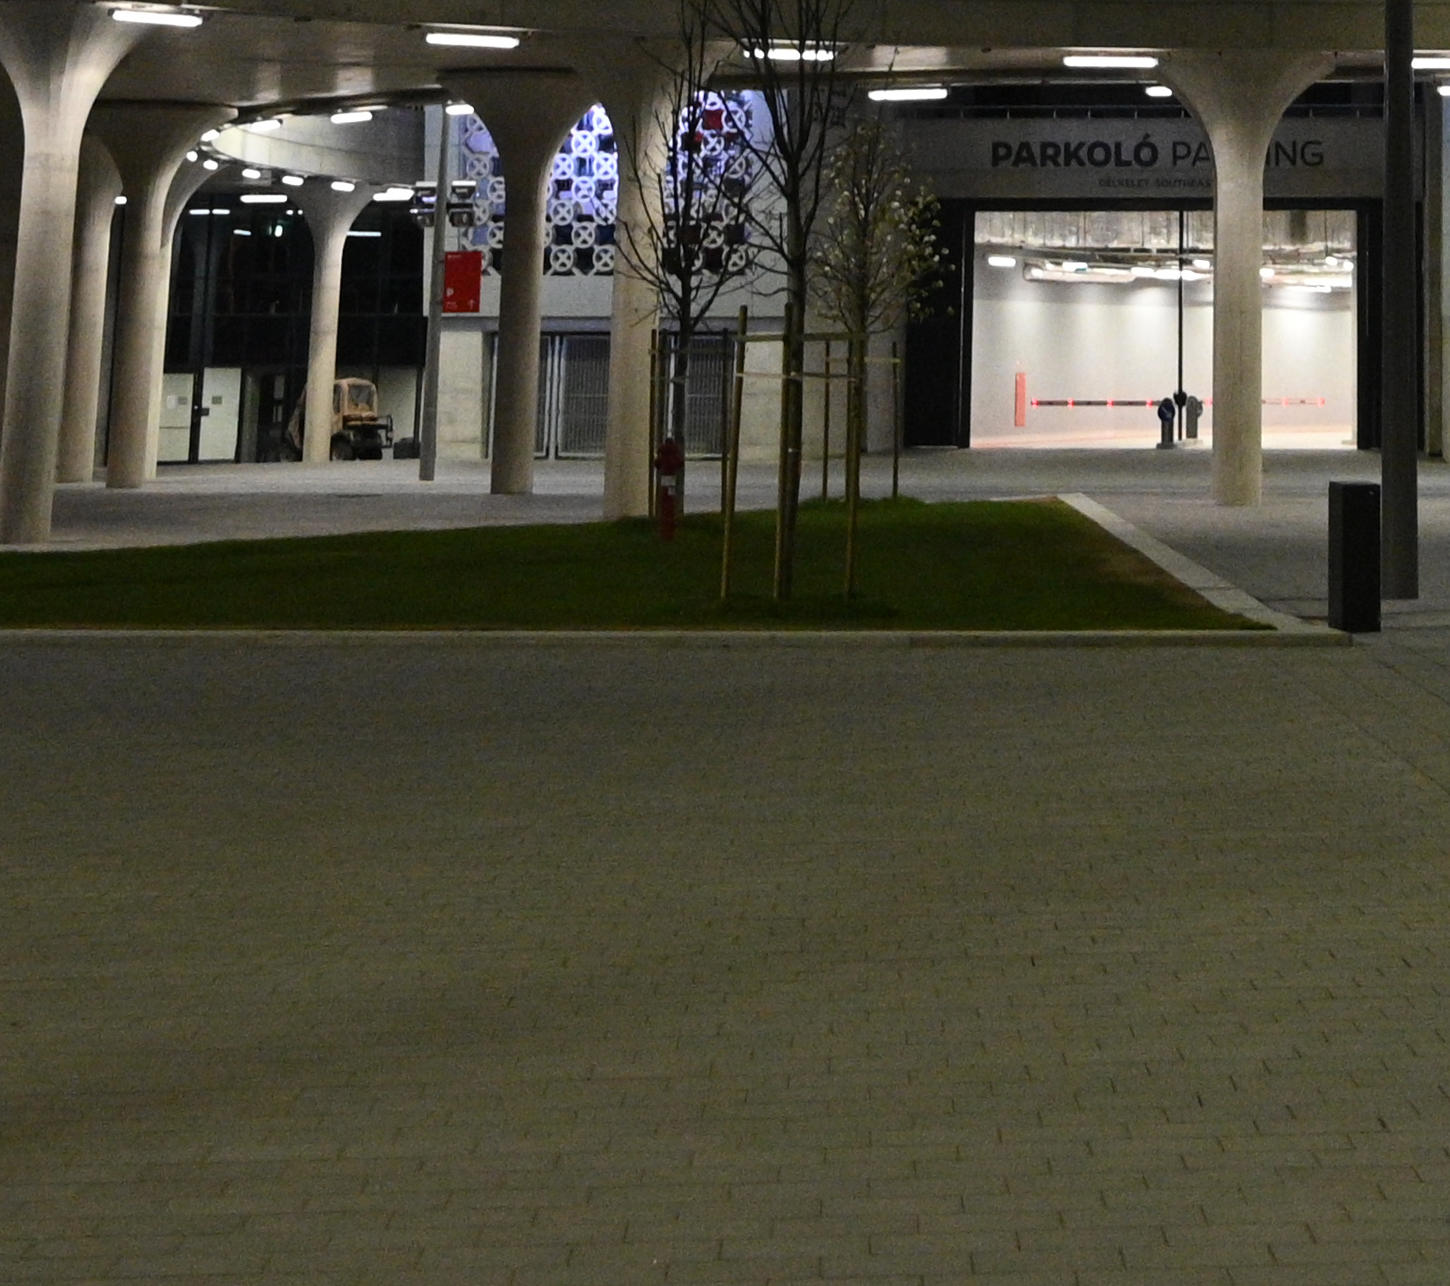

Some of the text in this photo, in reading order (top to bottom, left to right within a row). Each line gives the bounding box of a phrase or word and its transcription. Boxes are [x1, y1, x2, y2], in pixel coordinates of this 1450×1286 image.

[991, 133, 1324, 167] PARKOLÓ PAING
[1155, 177, 1213, 189] SOUTHEAS
